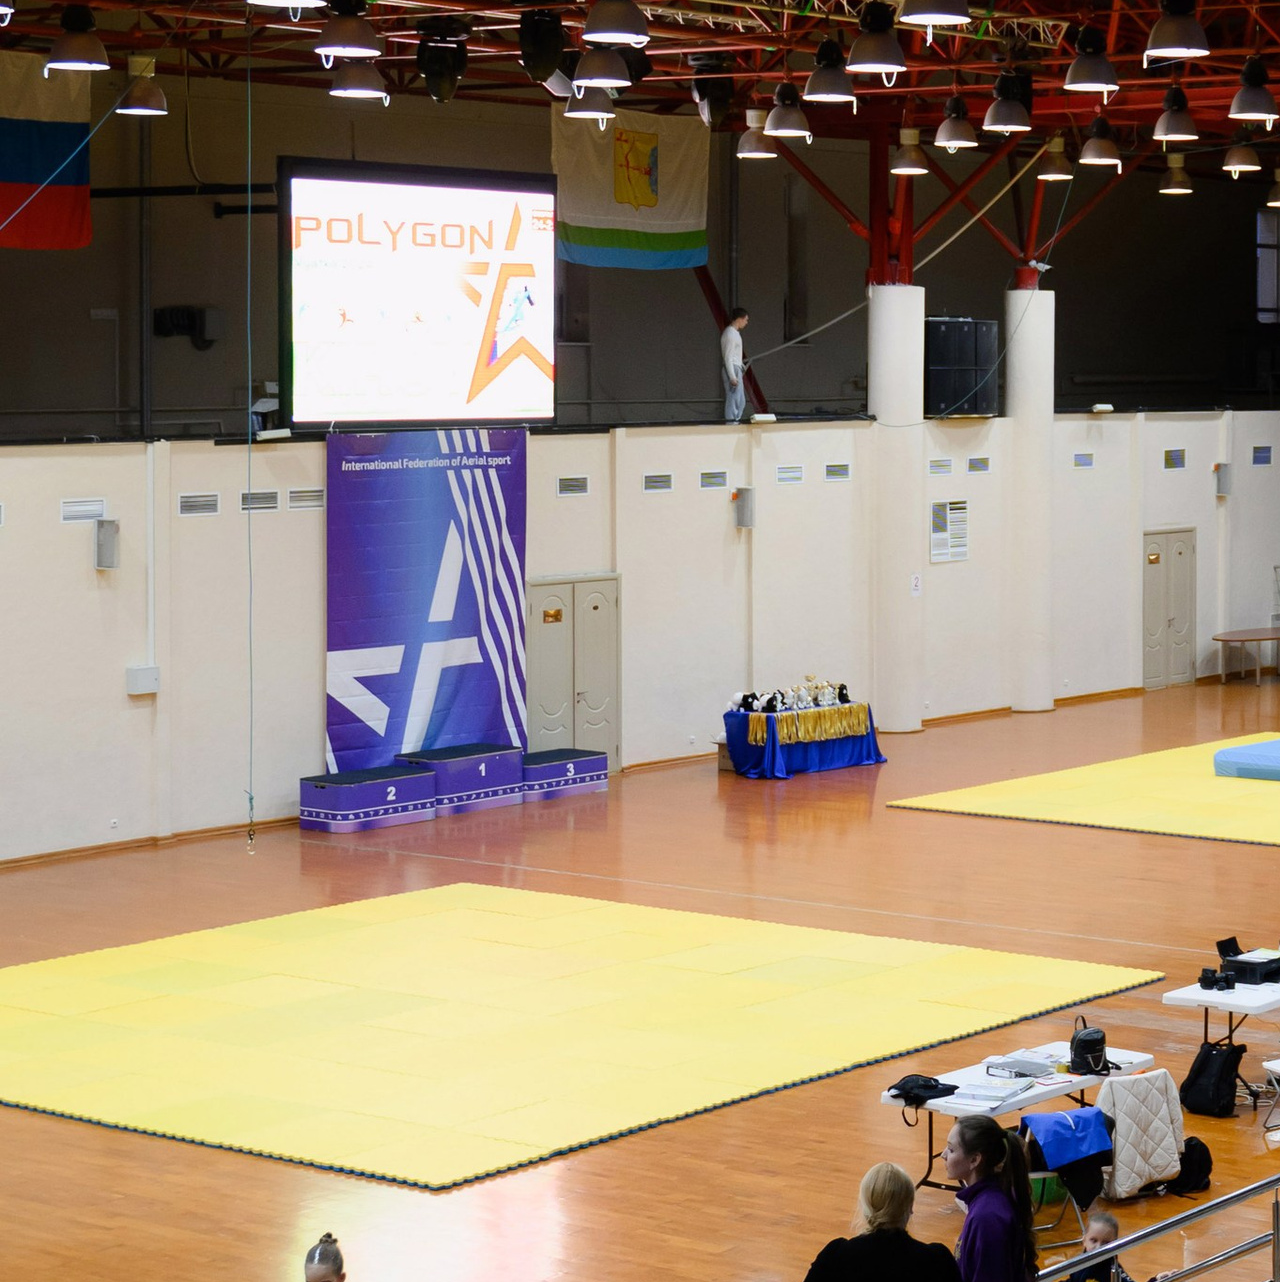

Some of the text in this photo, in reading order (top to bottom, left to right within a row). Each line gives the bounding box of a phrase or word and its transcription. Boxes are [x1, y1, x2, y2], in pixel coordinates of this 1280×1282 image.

[293, 213, 494, 255] POLYGON
[341, 455, 511, 471] International Federation of Aerial sport
[478, 762, 486, 777] 1
[566, 763, 575, 777] 3
[386, 786, 396, 801] 2
